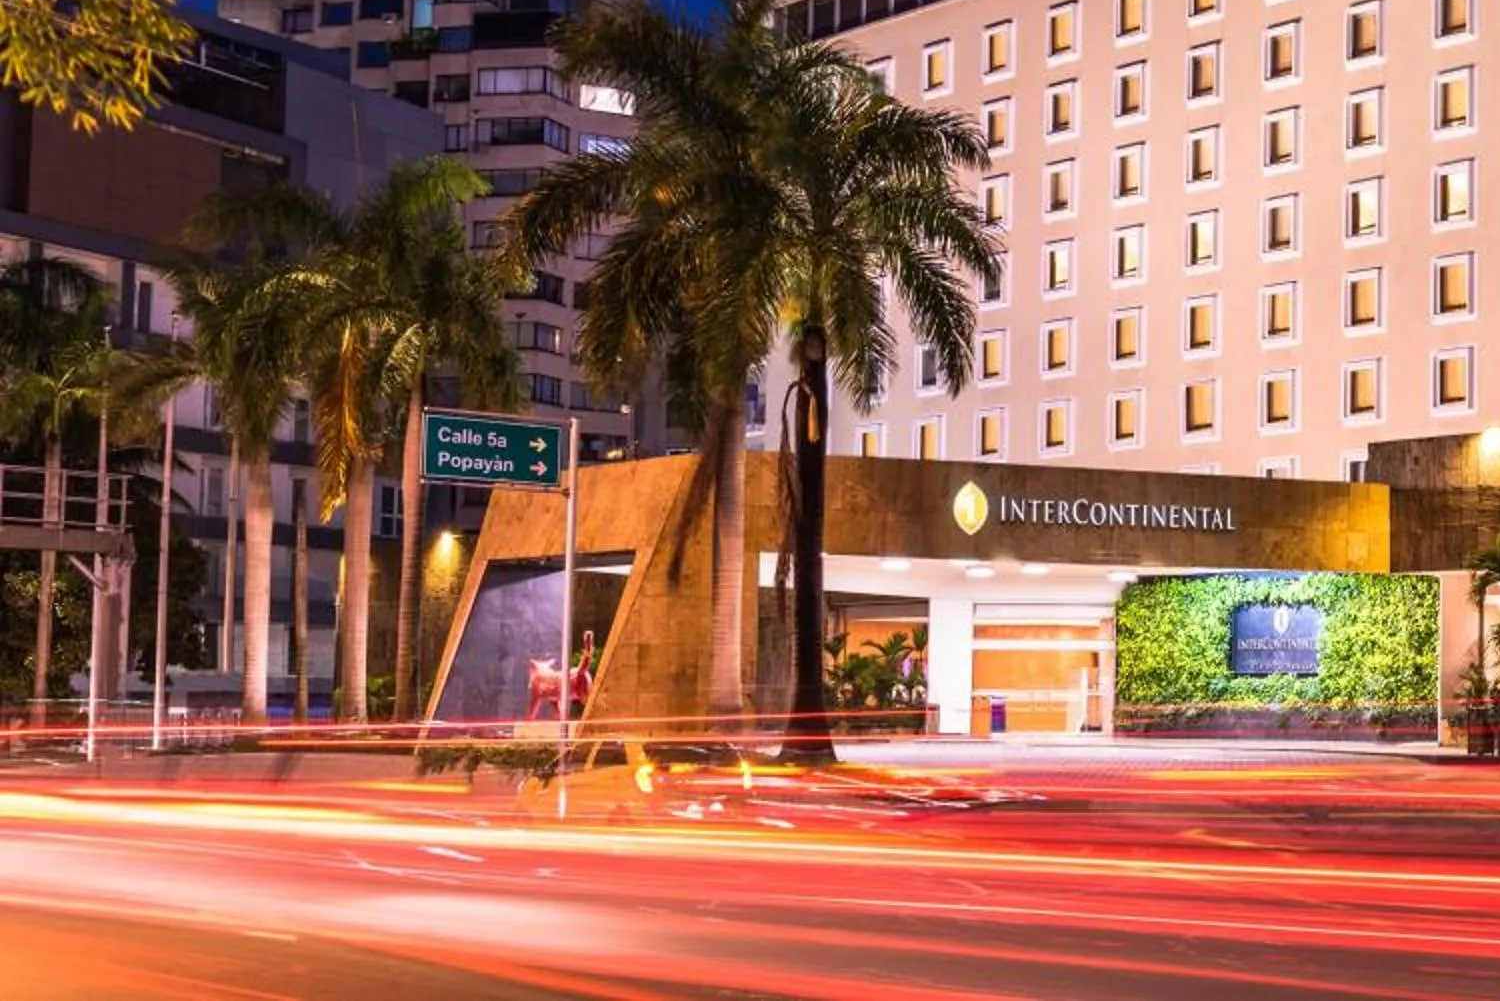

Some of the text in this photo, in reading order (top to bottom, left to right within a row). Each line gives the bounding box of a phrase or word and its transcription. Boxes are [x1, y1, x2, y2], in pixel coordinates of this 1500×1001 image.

[437, 426, 507, 448] Calle 5a
[437, 452, 514, 474] Popayán
[1000, 496, 1236, 530] INTERCONTINENTAL
